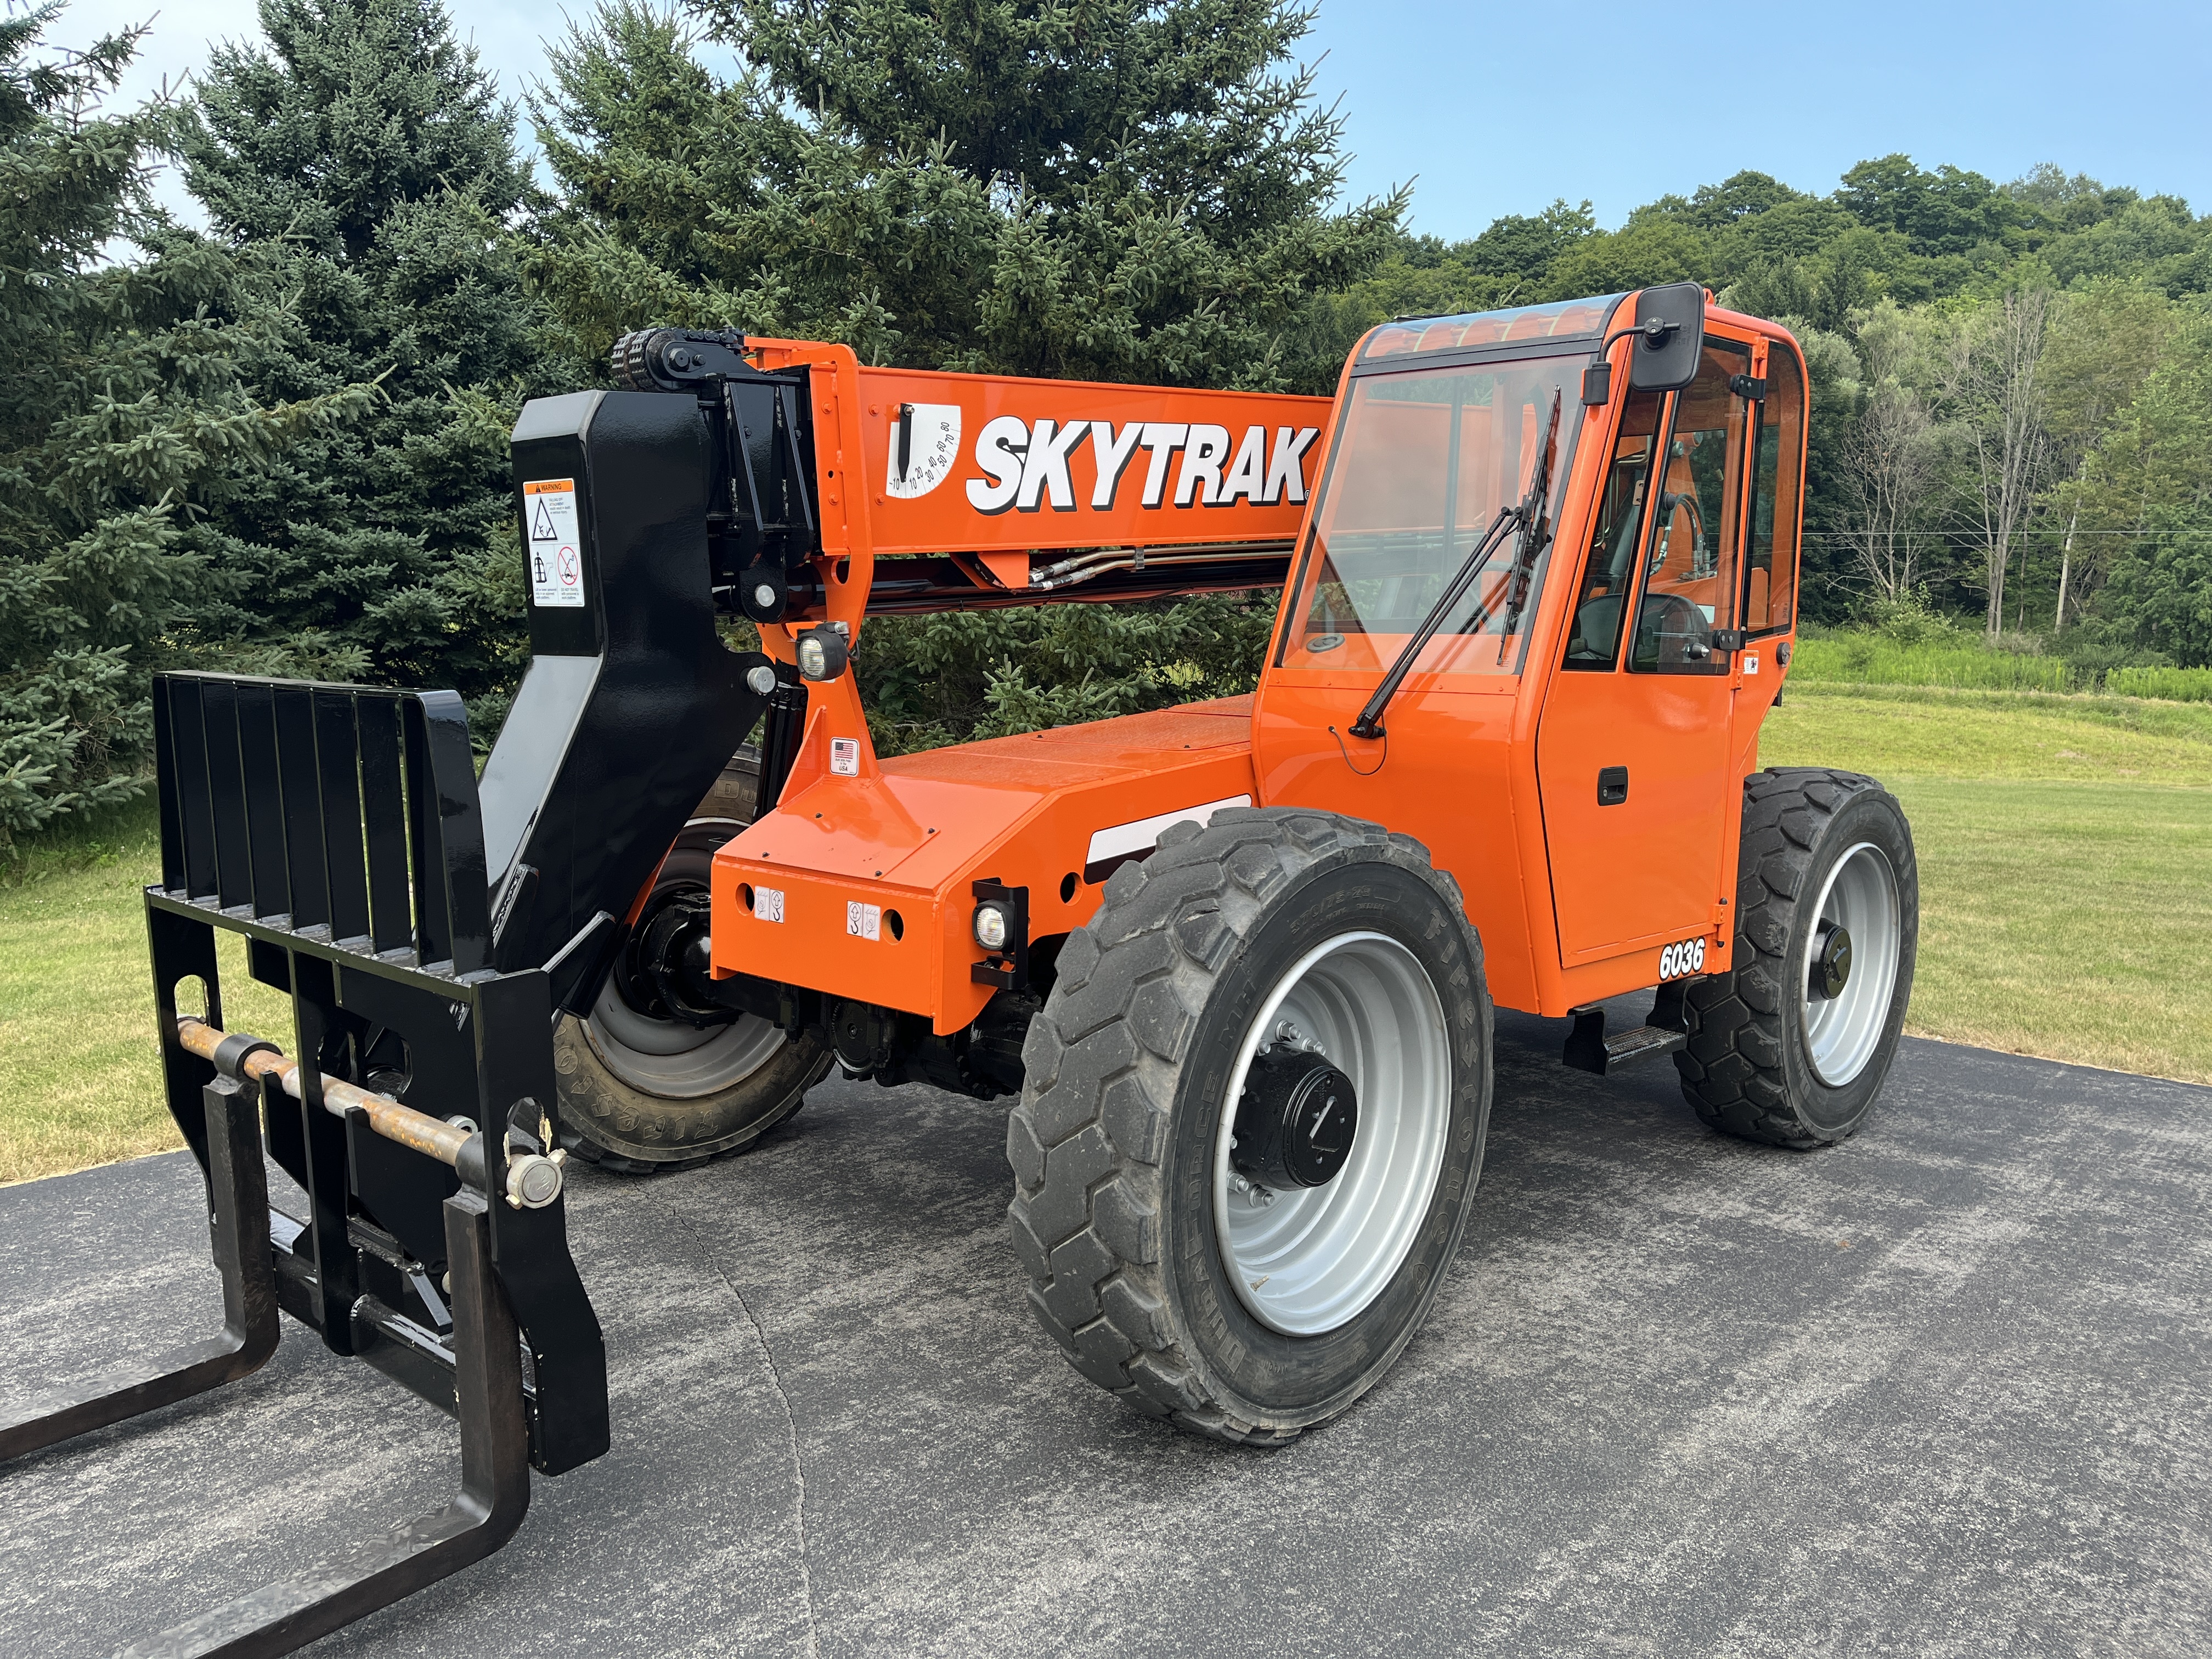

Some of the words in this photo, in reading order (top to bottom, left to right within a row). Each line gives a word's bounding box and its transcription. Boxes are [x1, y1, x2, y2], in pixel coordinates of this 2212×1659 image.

[940, 422, 950, 432] 80
[945, 434, 954, 445] 70
[936, 441, 946, 453] 60
[928, 456, 937, 469] 40
[937, 454, 947, 467] 50
[966, 415, 1321, 516] SKYTRAK
[915, 466, 923, 479] 20
[925, 469, 934, 483] 30
[889, 477, 900, 490] -10
[909, 477, 917, 490] 10
[1659, 936, 1705, 981] 6036
[1184, 1070, 1247, 1374] DURAFORCE
[1218, 979, 1256, 1051] MH
